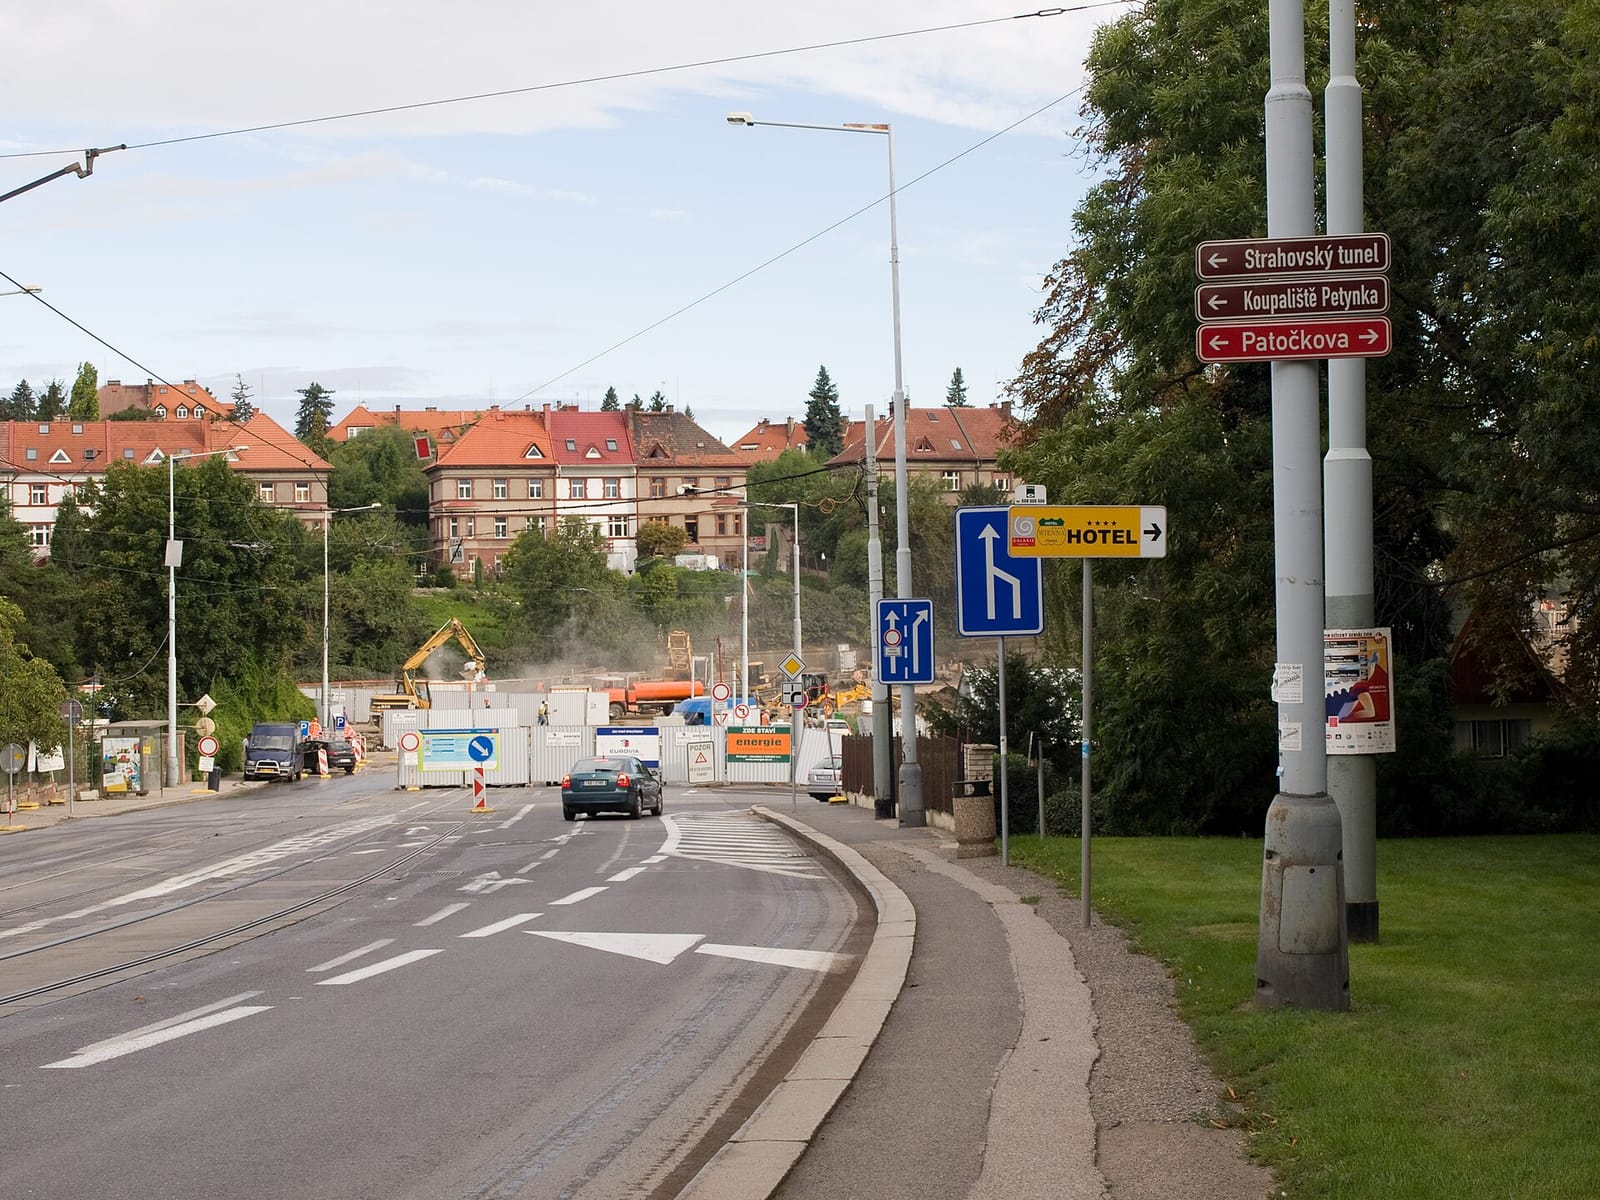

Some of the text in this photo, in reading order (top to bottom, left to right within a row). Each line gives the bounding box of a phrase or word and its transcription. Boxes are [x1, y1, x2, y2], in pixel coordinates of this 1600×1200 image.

[1244, 242, 1380, 270] Strahovský tunel
[1243, 284, 1379, 315] Koupaliště Petynka
[1242, 329, 1350, 352] Patočkova
[1067, 529, 1138, 544] HOTEL
[337, 717, 344, 727] P
[736, 737, 782, 747] energie
